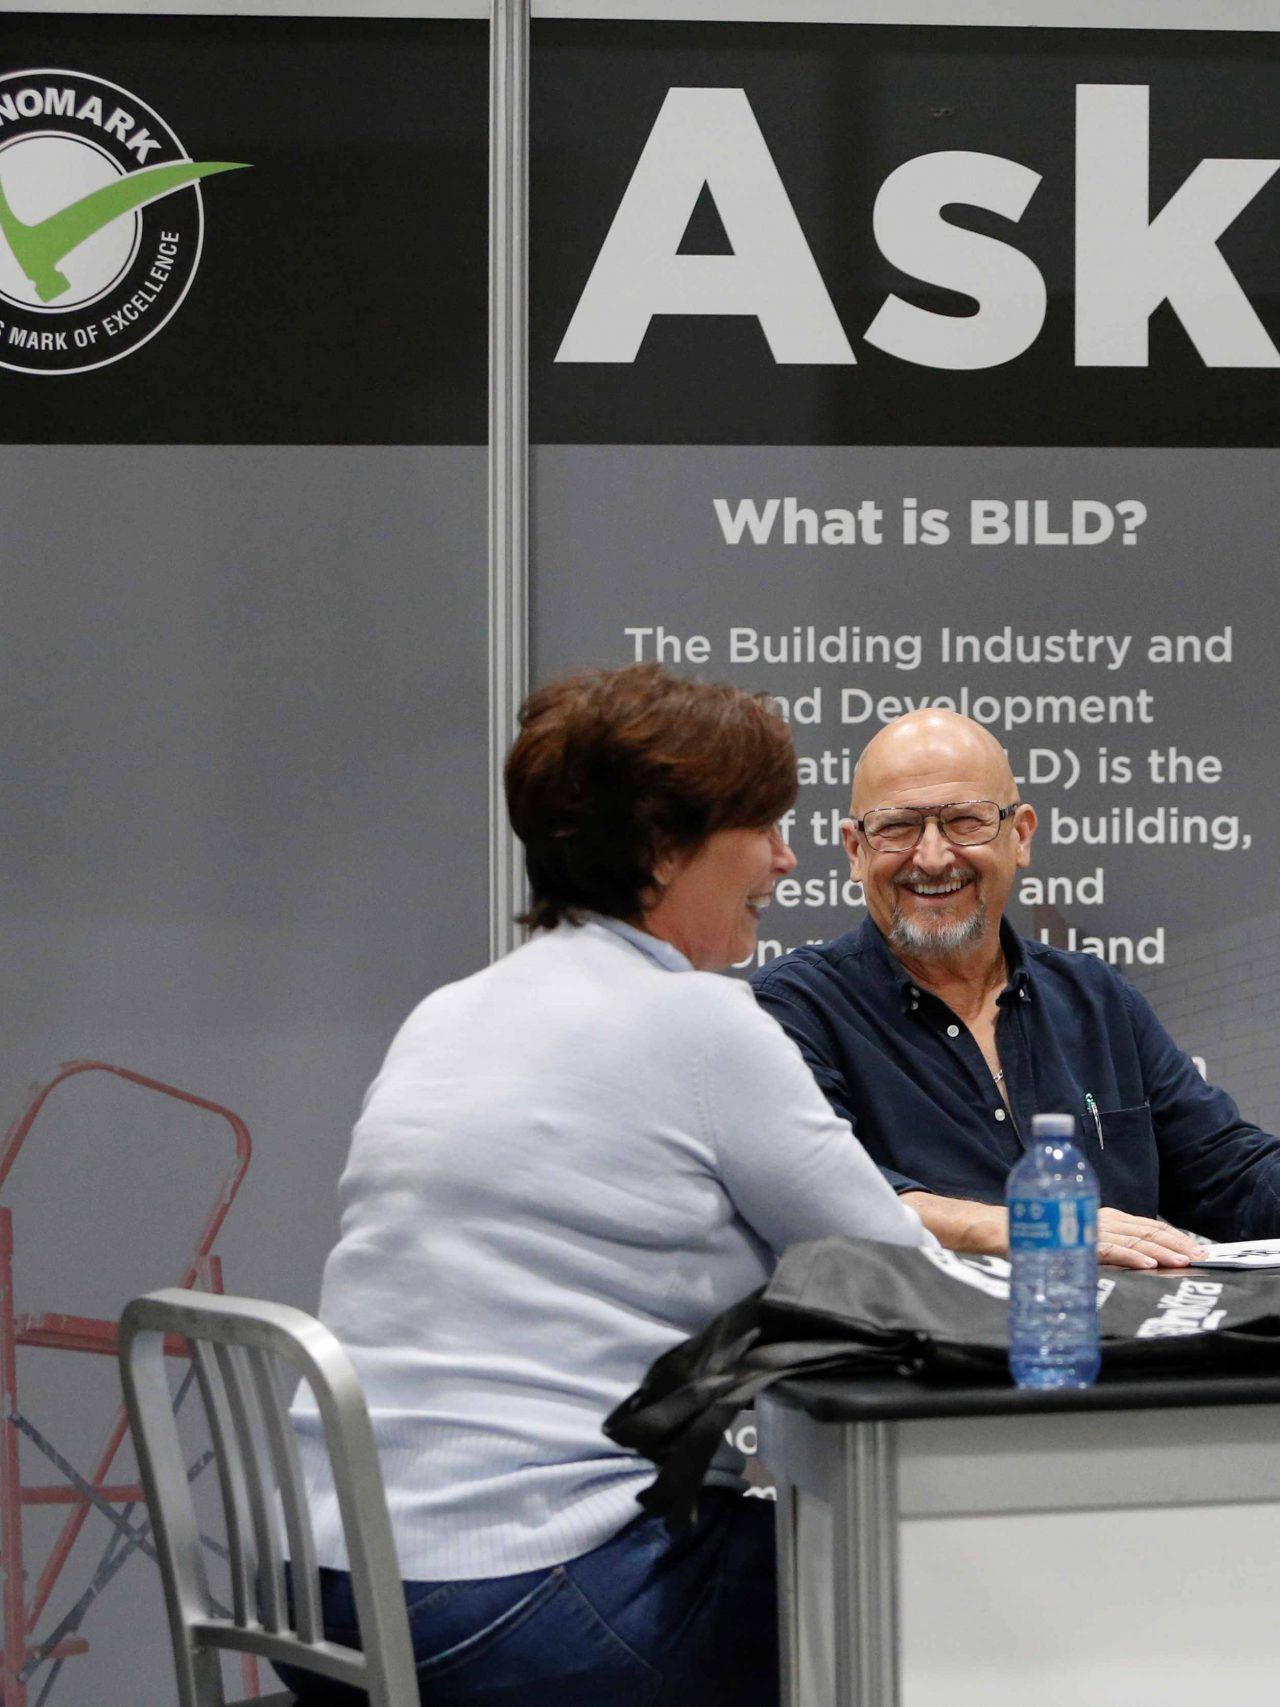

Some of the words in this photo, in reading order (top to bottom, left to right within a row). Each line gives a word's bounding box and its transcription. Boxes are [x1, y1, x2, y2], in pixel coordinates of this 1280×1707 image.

[8, 327, 68, 351] MARK
[74, 325, 98, 348] OF
[102, 230, 180, 337] EXCELLENCE
[713, 497, 882, 545] What
[903, 498, 950, 545] is
[971, 500, 1147, 545] BILD?
[625, 626, 710, 663] The
[730, 626, 921, 670] Building
[942, 626, 1132, 670] Industry
[1148, 626, 1232, 662] and
[1099, 747, 1132, 783] is
[1148, 747, 1222, 783] the
[1052, 807, 1251, 850] building,
[1019, 868, 1103, 905] and
